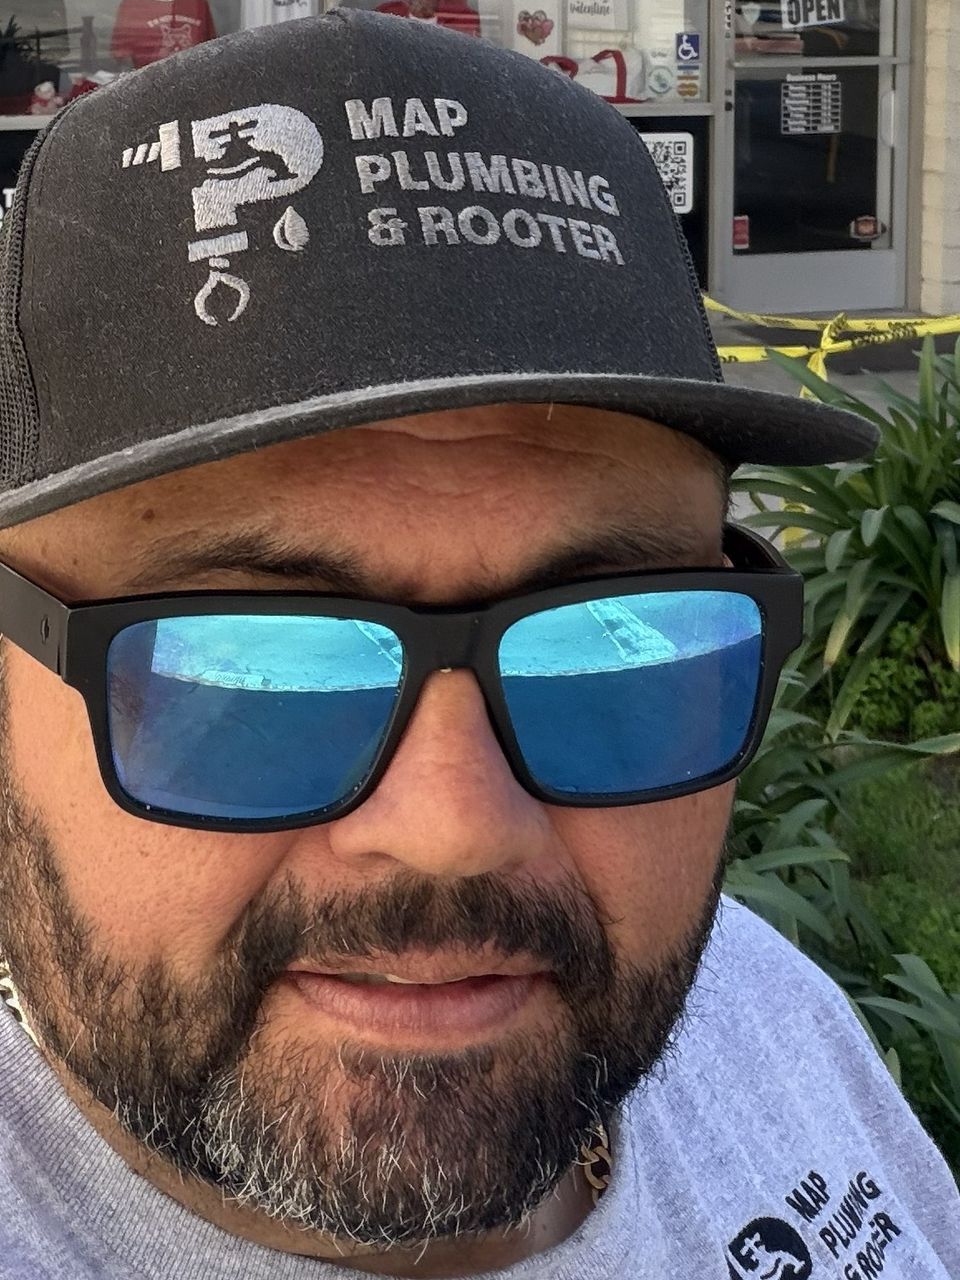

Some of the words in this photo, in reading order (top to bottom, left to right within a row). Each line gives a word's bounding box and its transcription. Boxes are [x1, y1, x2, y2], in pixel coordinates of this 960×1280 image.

[345, 97, 468, 140] MAP
[355, 150, 620, 217] PLUMBING
[367, 207, 409, 246] &
[417, 205, 626, 266] ROOTER
[785, 1170, 831, 1223] MAP
